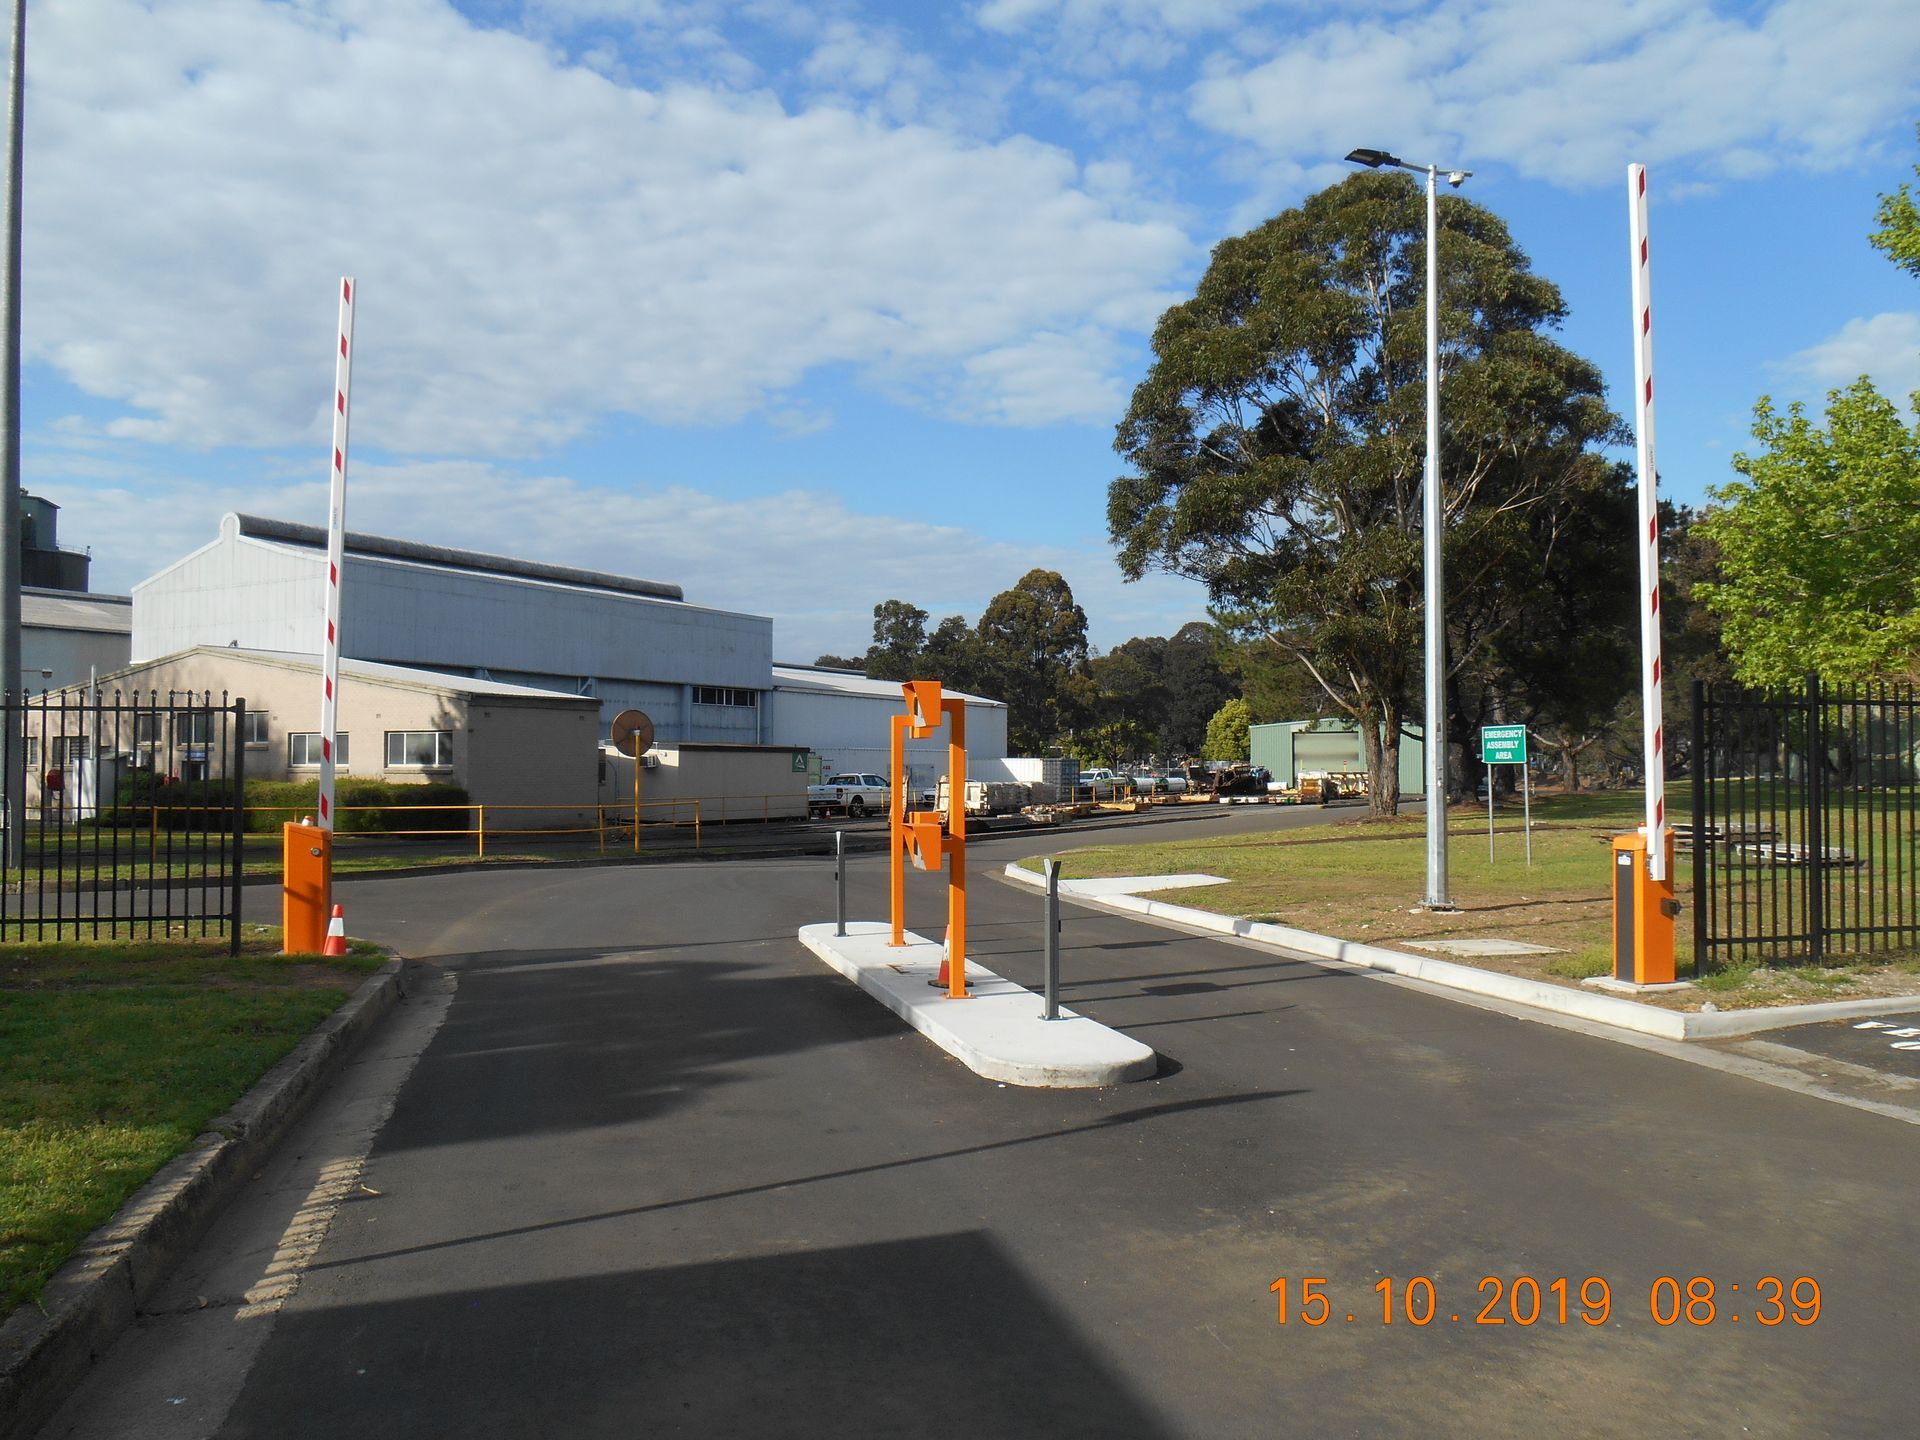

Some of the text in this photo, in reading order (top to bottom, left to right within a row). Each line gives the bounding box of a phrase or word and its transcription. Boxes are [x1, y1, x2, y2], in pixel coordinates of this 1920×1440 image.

[1484, 729, 1523, 739] EMERGENCY
[1487, 740, 1519, 750] ASSEMBLY
[1495, 751, 1513, 760] AREA
